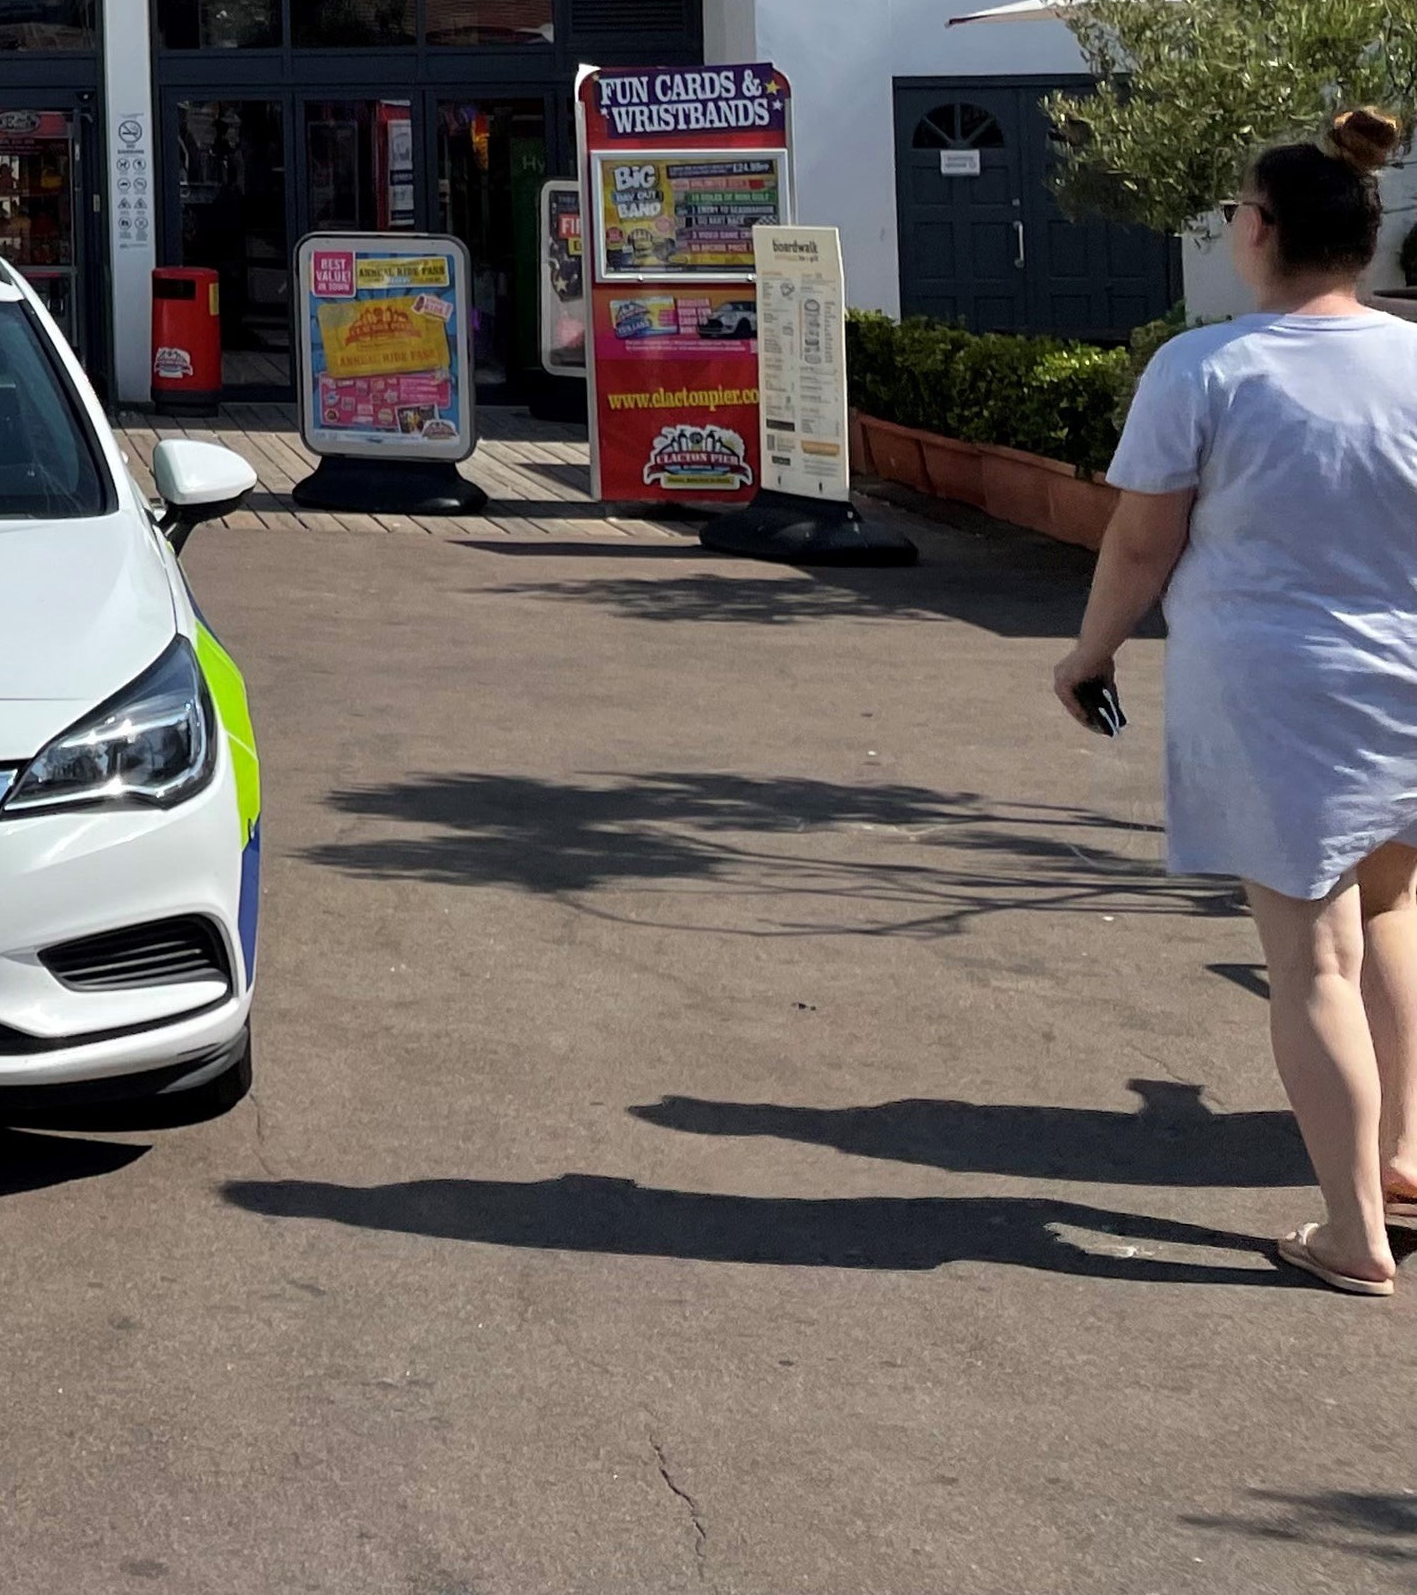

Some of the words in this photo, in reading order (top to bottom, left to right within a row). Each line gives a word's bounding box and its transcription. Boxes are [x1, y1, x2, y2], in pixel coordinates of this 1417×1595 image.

[599, 76, 649, 105] FUN
[654, 70, 736, 102] CARDS
[741, 69, 763, 98] &
[612, 98, 771, 134] WRISTBANDS
[617, 202, 662, 219] BAND
[772, 239, 819, 254] boardwalk
[320, 258, 347, 269] BEST
[315, 269, 352, 282] VALUE!
[656, 453, 708, 465] CLACTON
[710, 453, 738, 465] PIER
